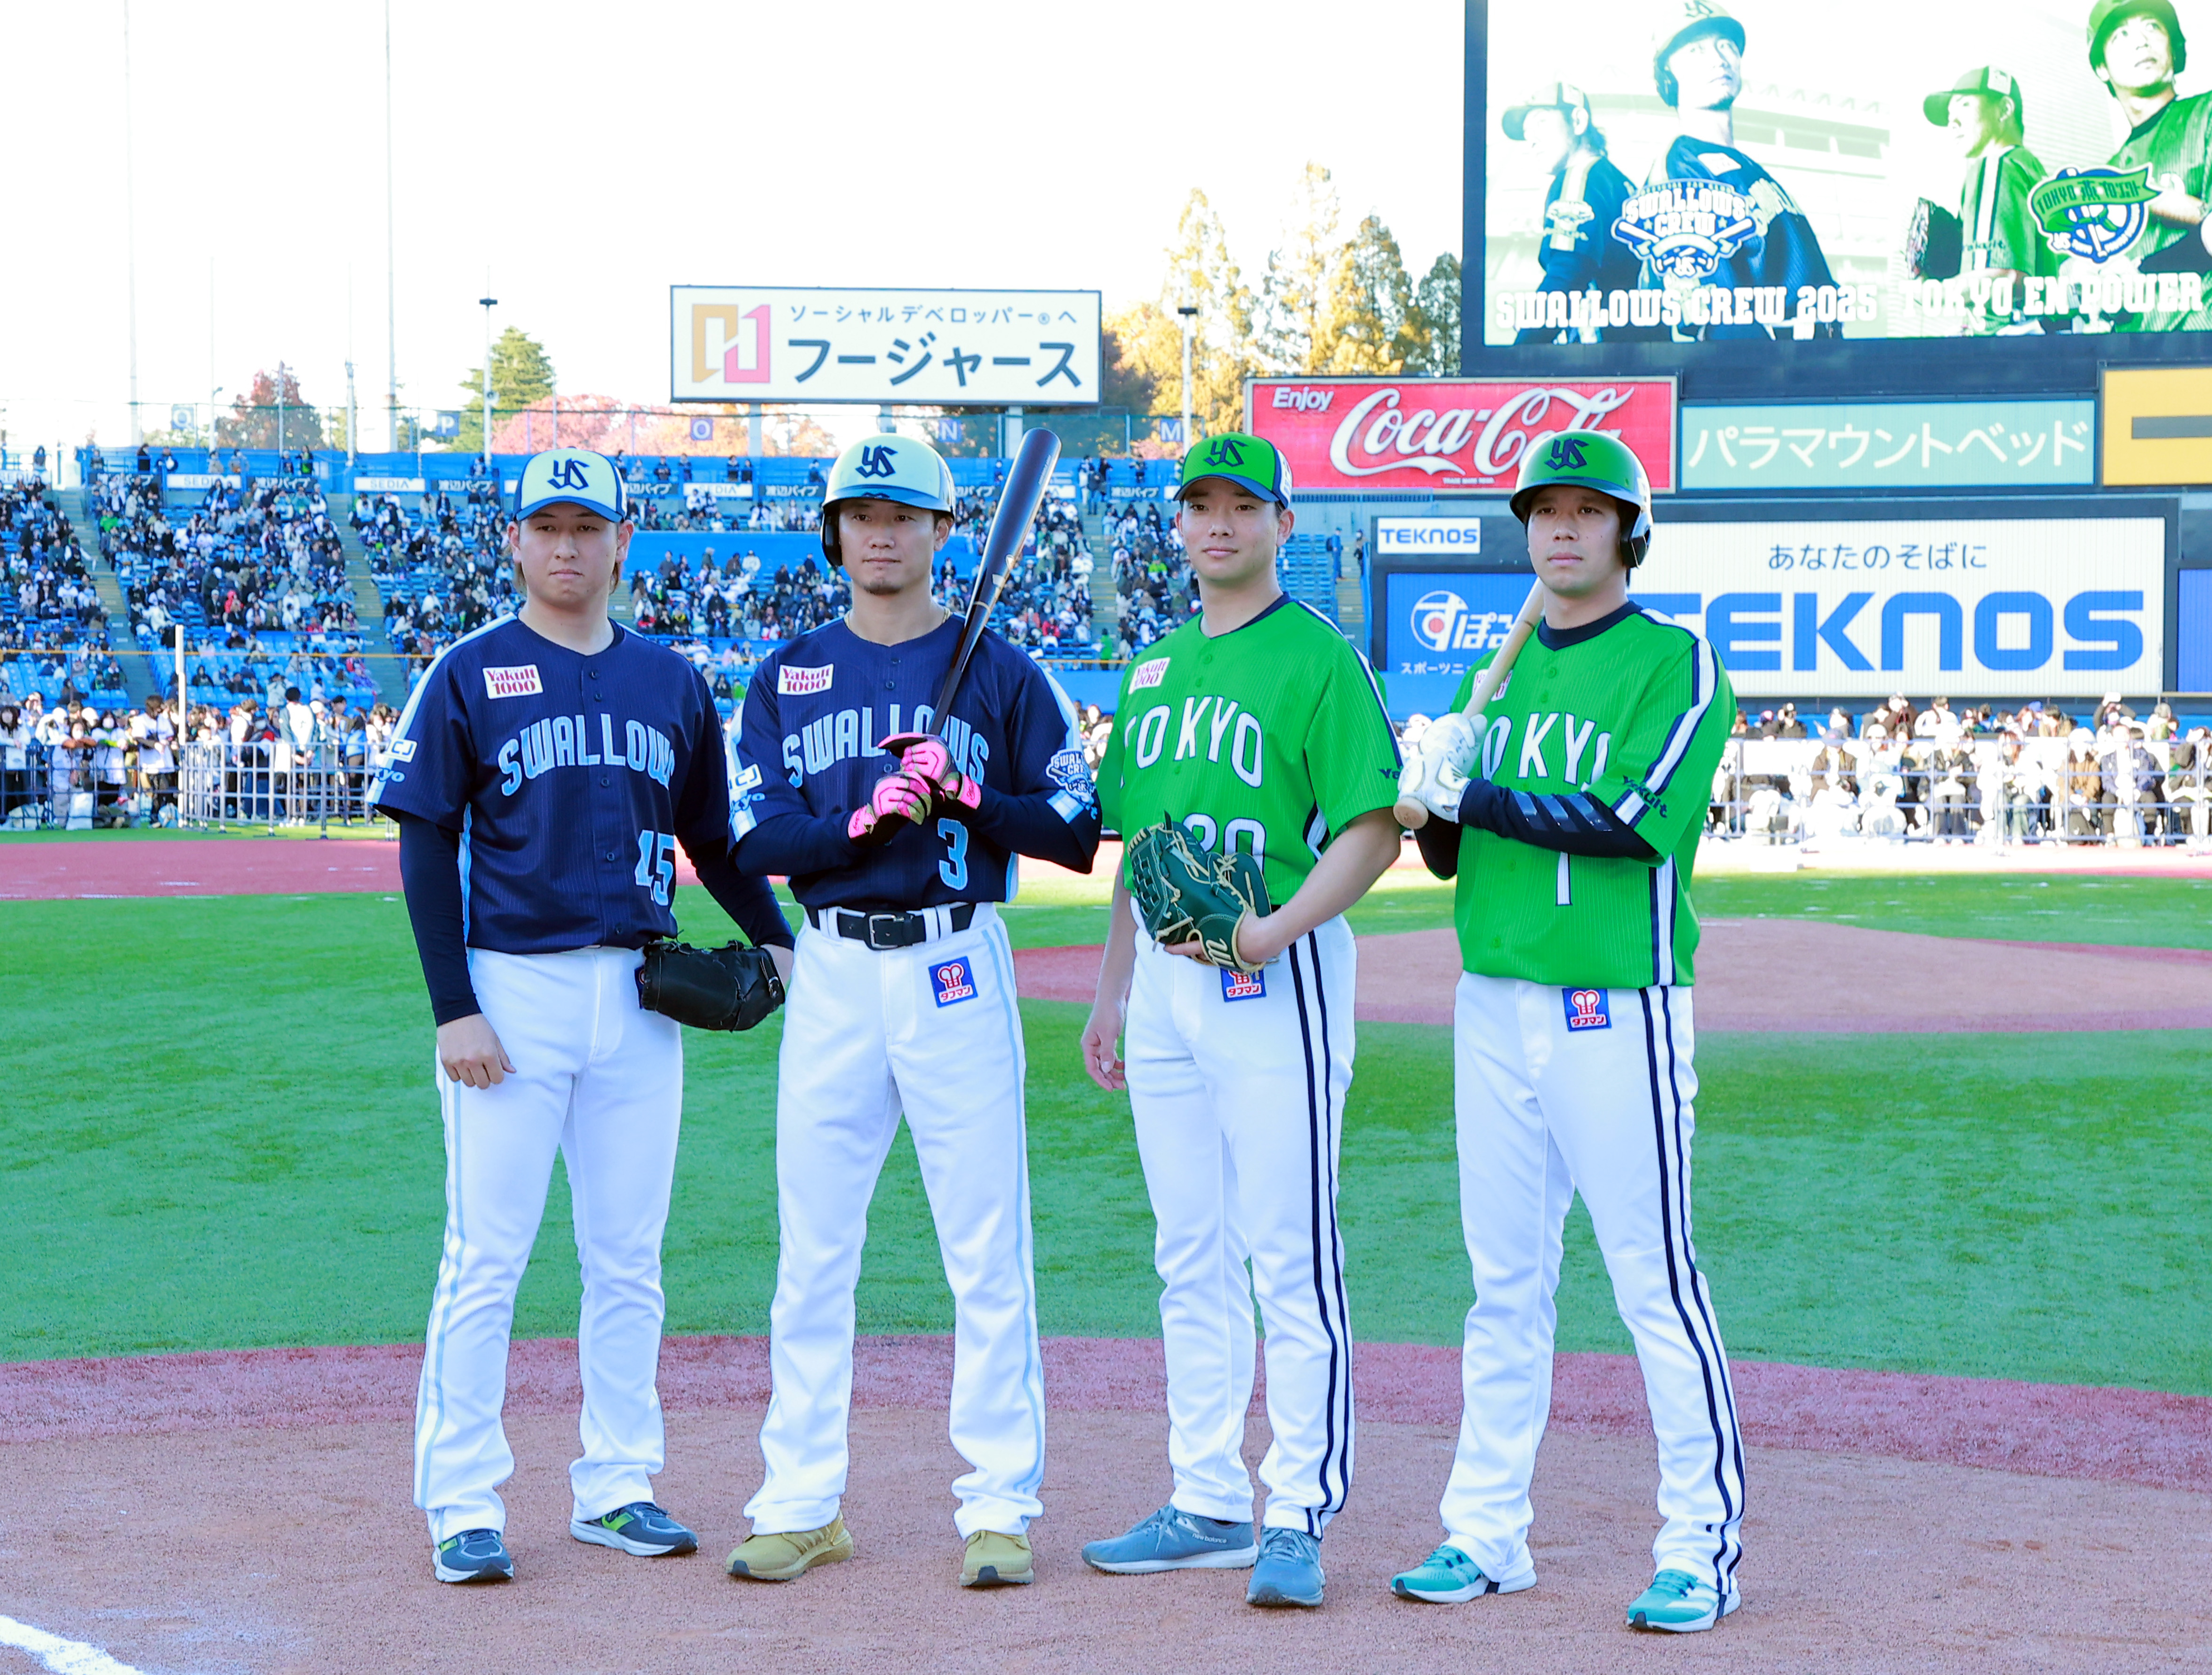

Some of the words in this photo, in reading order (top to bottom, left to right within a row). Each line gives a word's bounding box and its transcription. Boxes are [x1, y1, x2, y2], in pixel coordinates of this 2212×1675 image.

[1626, 187, 1746, 224] SWALLOWS
[2037, 184, 2077, 214] TOKYO
[1654, 211, 1716, 238] CREW
[1900, 277, 2014, 317] TOKYO
[2023, 276, 2070, 315] EN
[2079, 272, 2203, 314] POWER
[1496, 289, 1681, 328] SWALLOWS
[1693, 286, 1787, 325] CREW
[1797, 284, 1877, 322] 2025
[788, 331, 1082, 388] フージャース
[1272, 387, 1334, 411] Enjoy
[441, 416, 455, 432] P
[942, 419, 957, 440] N
[1160, 424, 1181, 441] M
[1688, 419, 2089, 469] パラマウントベッド
[370, 479, 409, 489] SEDIA
[1380, 529, 1477, 544] TEKNOS
[1768, 541, 1988, 571] あなたのそばに
[486, 668, 537, 682] Yakult
[783, 668, 830, 681] Yakult
[1401, 662, 1471, 675] スポーツニ
[492, 680, 536, 695] 1000
[785, 679, 826, 692] 1000
[937, 817, 969, 891] 3
[634, 829, 675, 907] 45
[941, 987, 970, 1001] タフマン
[1227, 985, 1260, 997] タフマン
[1572, 1016, 1604, 1027] タフマン
